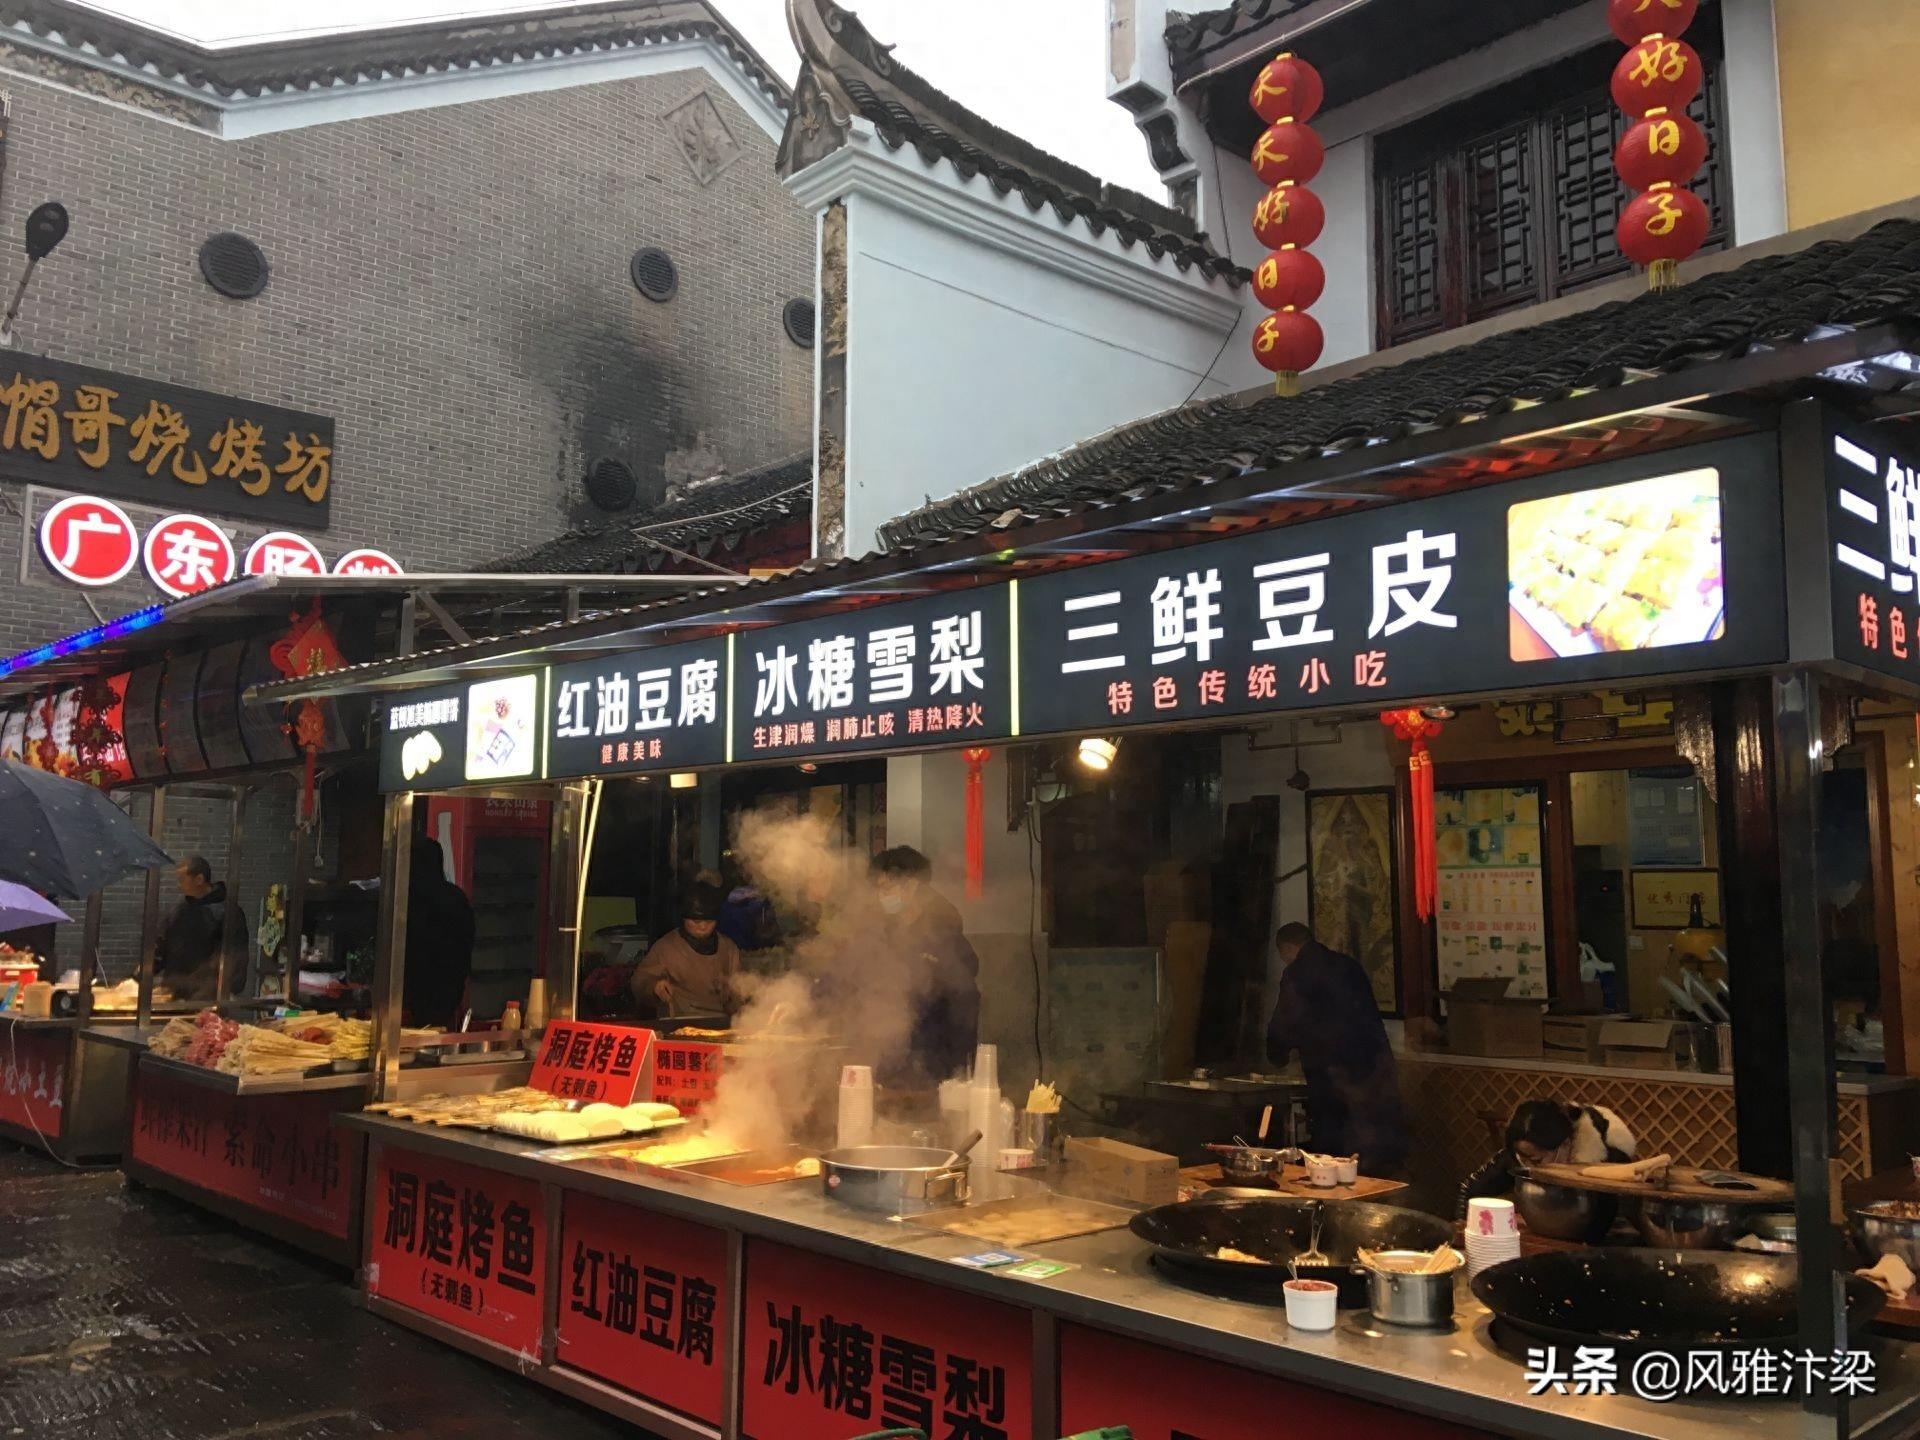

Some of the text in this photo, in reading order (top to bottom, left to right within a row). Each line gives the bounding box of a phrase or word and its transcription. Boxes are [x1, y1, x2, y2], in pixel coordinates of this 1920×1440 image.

[1252, 65, 1289, 352] 天天好日子
[1061, 529, 1459, 674] 三鲜豆皮
[1858, 592, 1920, 660] 特色
[556, 656, 719, 740] 红油豆腐
[754, 609, 985, 718] 冰糖雪梨
[1107, 650, 1388, 715] 特色传统小吃
[601, 739, 663, 765] 健康美味
[752, 702, 984, 749] 生津润燥 润肺止咳 清热降火
[542, 1027, 637, 1077] 洞庭烤鱼
[383, 1170, 537, 1296] 洞庭烤鱼
[571, 1240, 718, 1366] 红油豆腐
[763, 1300, 1009, 1440] 冰糖雪梨
